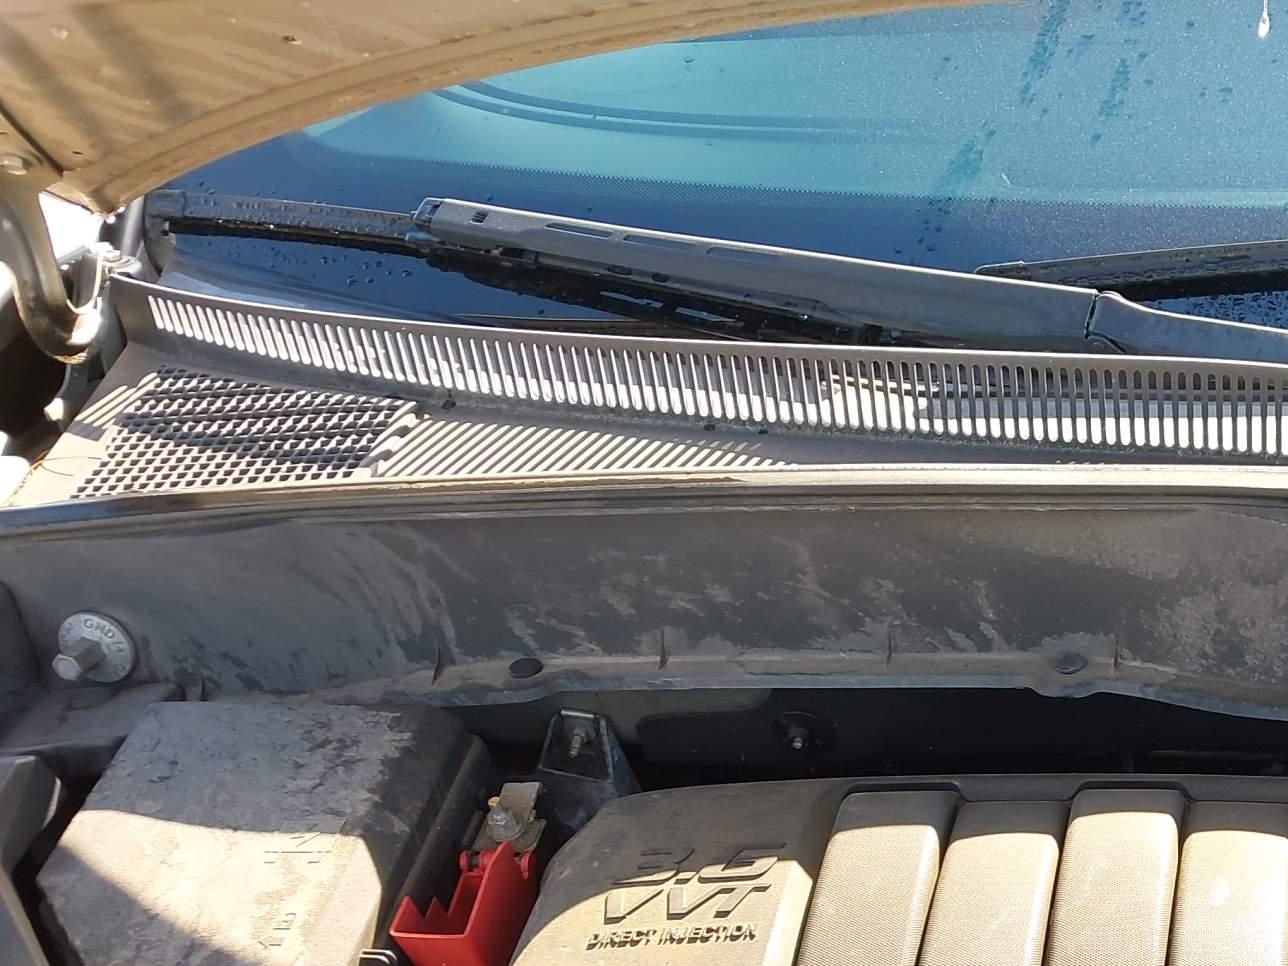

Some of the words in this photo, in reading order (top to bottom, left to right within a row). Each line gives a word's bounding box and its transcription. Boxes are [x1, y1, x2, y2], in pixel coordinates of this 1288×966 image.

[612, 843, 788, 886] 3.6
[604, 882, 773, 925] VVT
[585, 928, 658, 951] DIRECT
[657, 922, 757, 946] INJECTION
